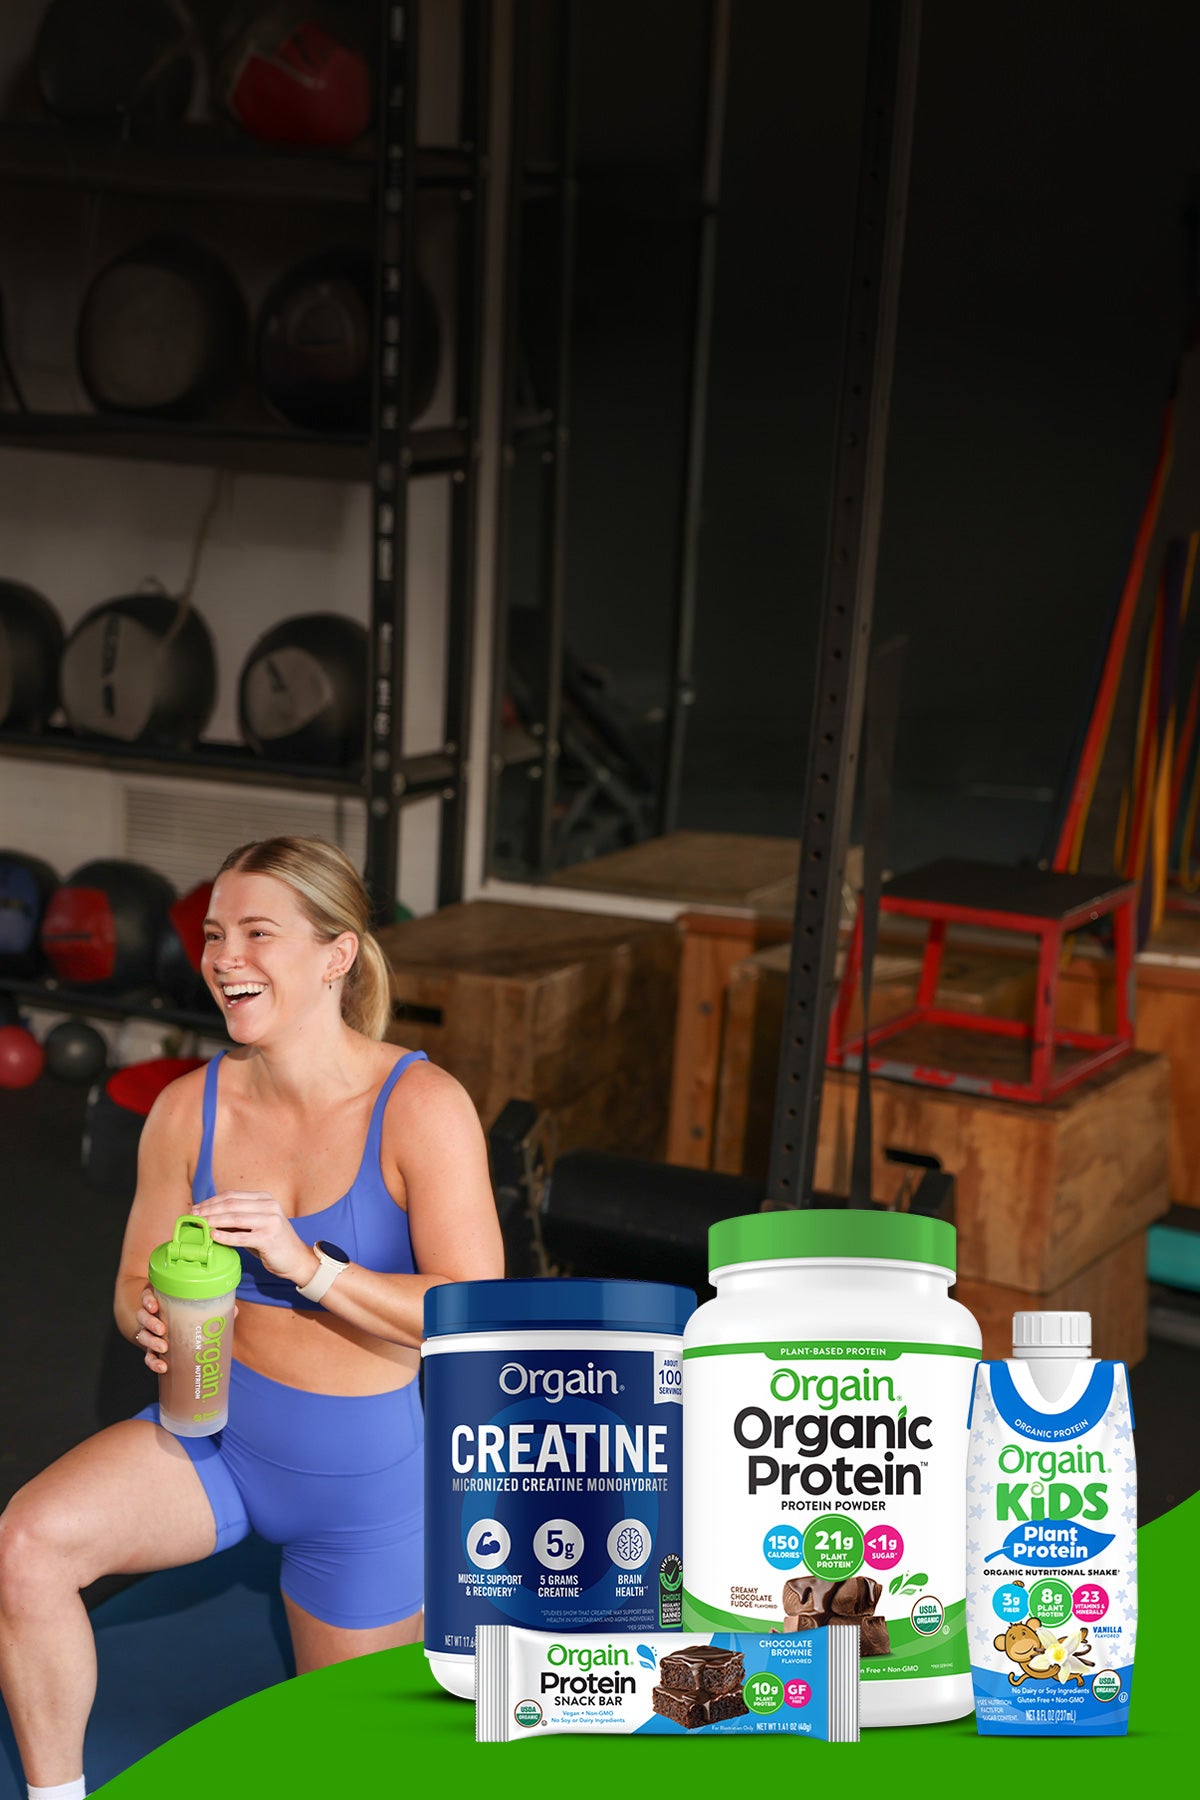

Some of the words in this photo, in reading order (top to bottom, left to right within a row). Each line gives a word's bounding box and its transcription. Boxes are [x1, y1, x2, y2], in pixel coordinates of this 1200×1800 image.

[780, 1348, 843, 1356] PLANT-BASED
[846, 1348, 886, 1356] PROTEIN
[658, 1370, 682, 1386] 100
[658, 1387, 682, 1396] SERVINGS
[734, 1405, 933, 1458] Organic
[1014, 1418, 1052, 1438] ORGANIC
[1054, 1418, 1089, 1438] PROTEIN
[451, 1424, 669, 1474] CREATINE
[452, 1478, 518, 1492] MICRONIZED
[522, 1478, 584, 1492] CREATINE
[586, 1478, 668, 1492] MONOHYDRATE
[781, 1500, 832, 1511] PROTEIN
[835, 1500, 886, 1511] POWDER
[1024, 1526, 1078, 1542] Plant
[546, 1530, 575, 1560] 5g
[768, 1536, 799, 1550] 150
[814, 1530, 854, 1551] 21g
[867, 1534, 897, 1550] <1g
[1013, 1543, 1088, 1558] Protein
[458, 1574, 484, 1584] MUSCLE
[486, 1574, 522, 1585] SUPPORT
[540, 1574, 546, 1585] 5
[548, 1574, 578, 1585] GRAMS
[618, 1574, 642, 1584] BRAIN
[466, 1586, 472, 1596] &
[730, 1586, 758, 1594] CREAMY
[730, 1594, 772, 1602] CHOCOLATE
[1002, 1593, 1020, 1606] 3g
[1040, 1588, 1063, 1604] 8g
[1080, 1590, 1100, 1602] 23
[730, 1600, 753, 1608] FUDGE
[918, 1604, 937, 1614] USDA
[1037, 1604, 1064, 1612] PLANT
[916, 1616, 940, 1624] ORGANIC
[1092, 1626, 1122, 1634] VANILLA
[444, 1635, 454, 1646] NET
[759, 1640, 813, 1648] CHOCOLATE
[771, 1648, 812, 1657] BROWNIE
[888, 1664, 918, 1673] Non-GMO
[540, 1670, 636, 1694] Protein
[1098, 1677, 1116, 1685] USDA
[752, 1682, 778, 1696] 10g
[788, 1684, 807, 1694] GF
[1022, 1688, 1038, 1696] Dairy
[1046, 1688, 1057, 1696] Soy
[1058, 1688, 1090, 1696] Ingredients
[554, 1696, 596, 1706] SNACK
[598, 1696, 622, 1706] BAR
[562, 1710, 580, 1718] Vegan
[1026, 1710, 1036, 1720] NET
[1041, 1710, 1046, 1720] FL
[1047, 1710, 1054, 1720] OZ
[1055, 1710, 1077, 1724] (237mL)
[756, 1722, 768, 1731] NET
[768, 1722, 777, 1731] WT
[790, 1722, 798, 1731] OZ
